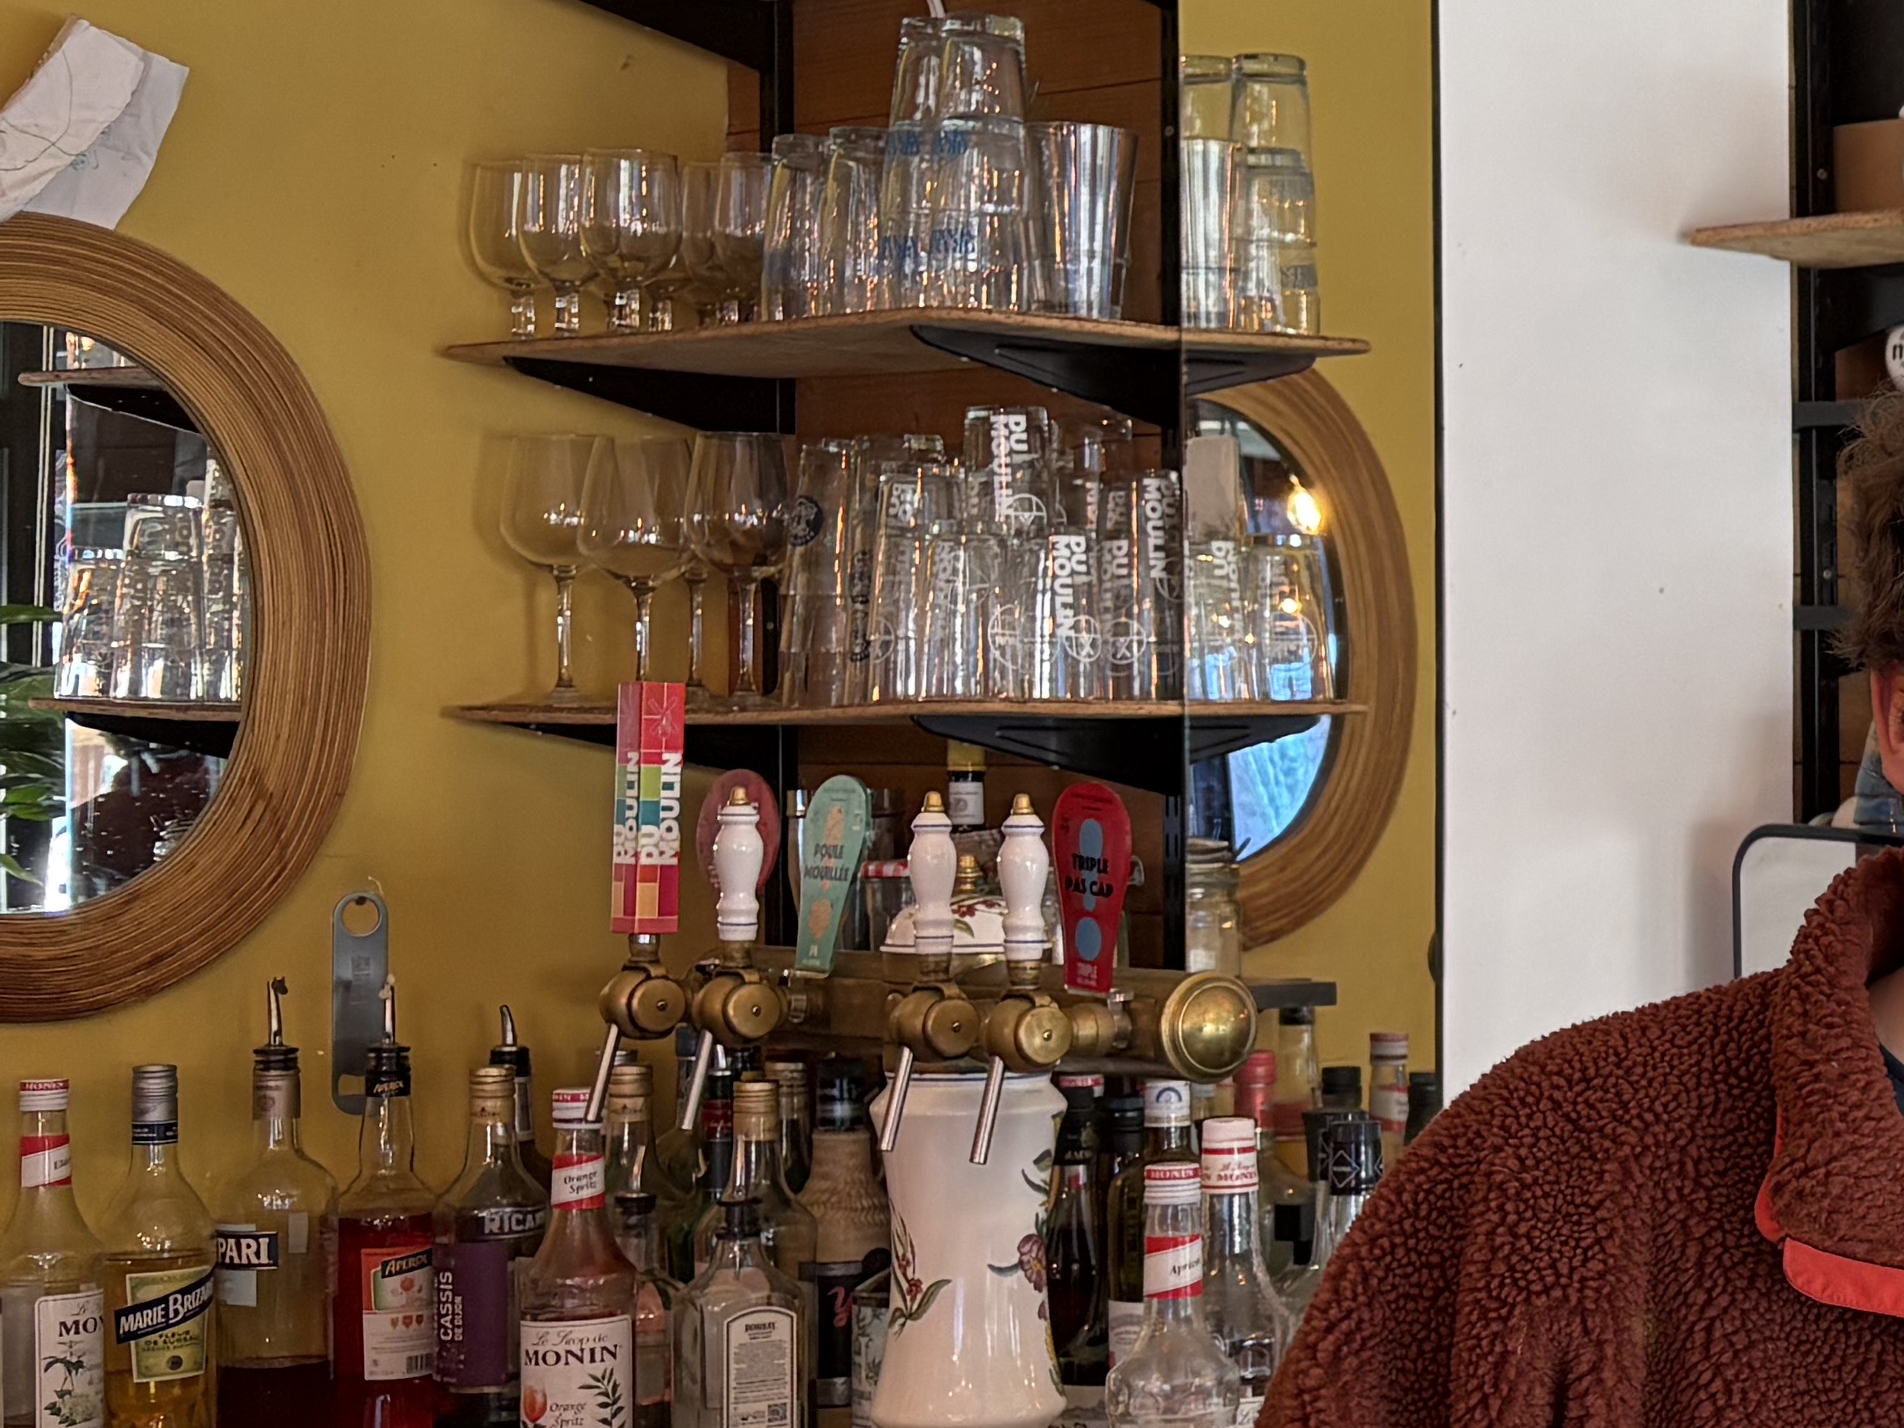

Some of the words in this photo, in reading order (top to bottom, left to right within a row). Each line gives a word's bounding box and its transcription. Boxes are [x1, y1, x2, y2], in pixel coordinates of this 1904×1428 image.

[1142, 477, 1167, 579] MOULIN
[1069, 535, 1089, 577] DU
[659, 752, 684, 864] MOULIN
[639, 824, 660, 864] DU
[1072, 853, 1109, 875] TRIPLE
[119, 1304, 167, 1334] MARIE
[439, 1271, 454, 1342] CASSIS
[524, 1343, 620, 1367] MONIN
[550, 1401, 588, 1416] Orange
